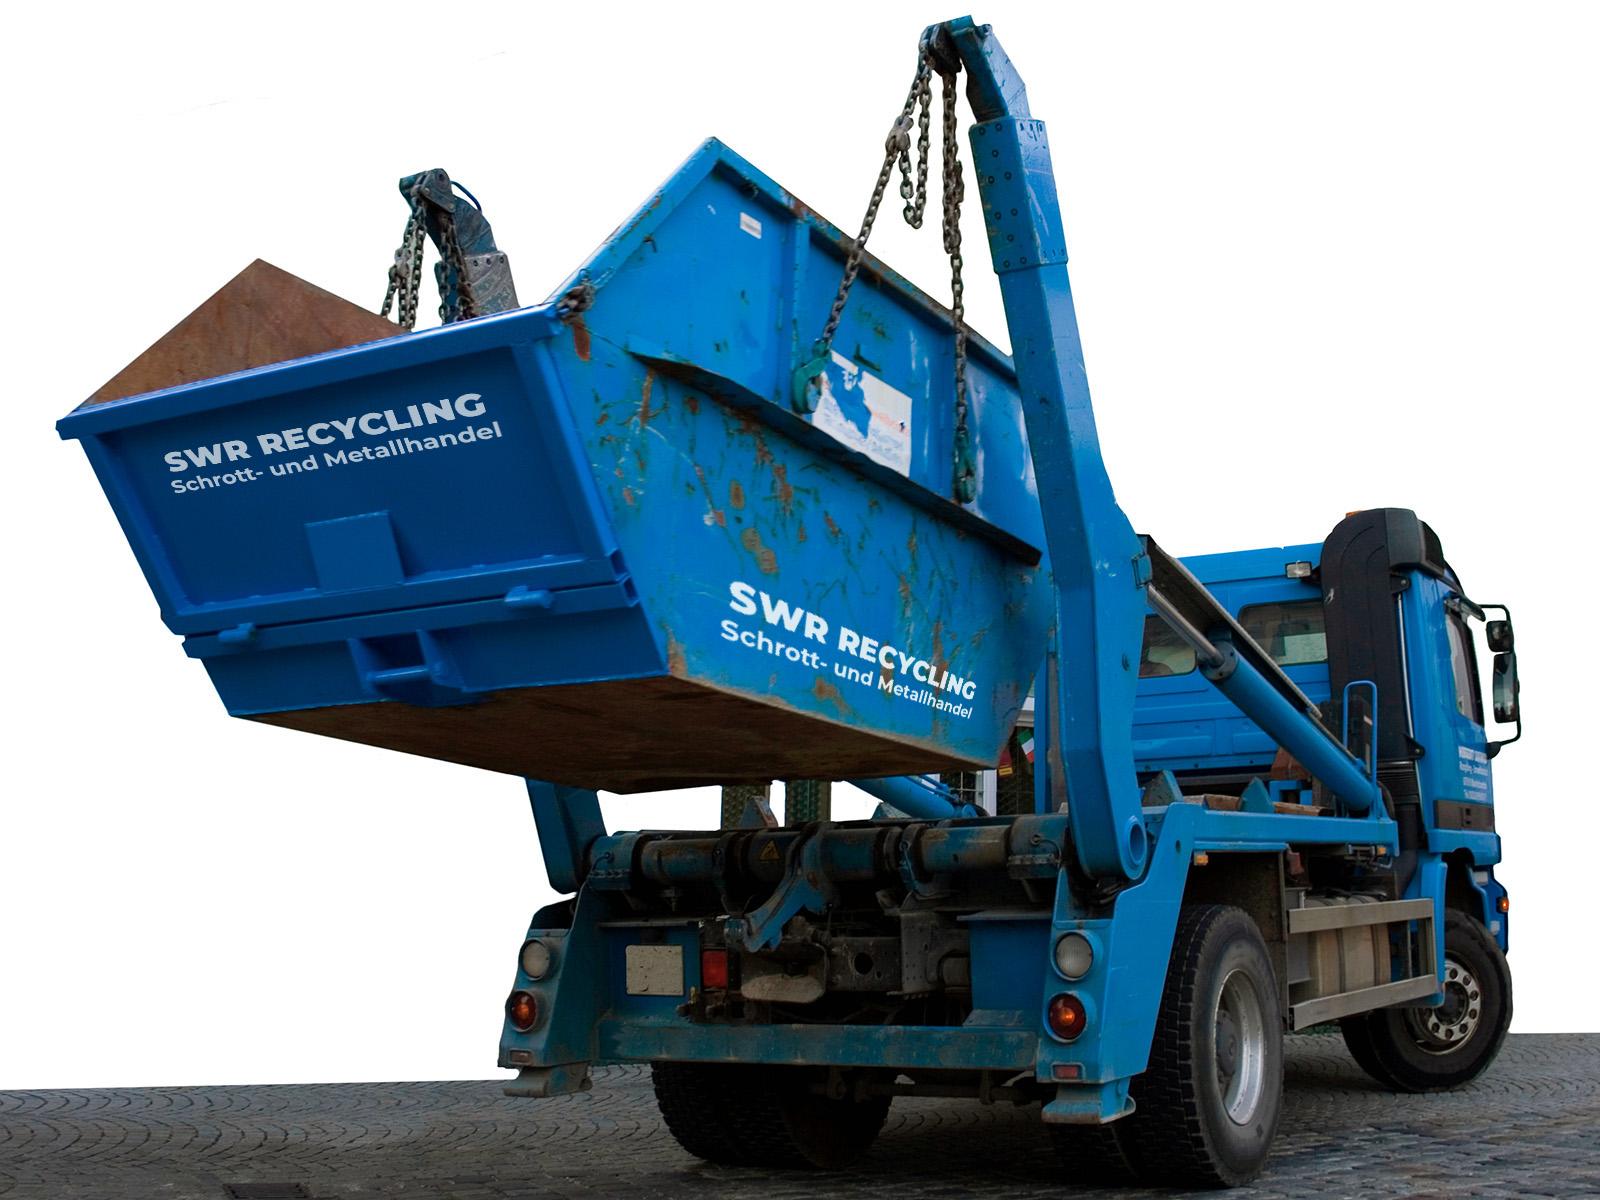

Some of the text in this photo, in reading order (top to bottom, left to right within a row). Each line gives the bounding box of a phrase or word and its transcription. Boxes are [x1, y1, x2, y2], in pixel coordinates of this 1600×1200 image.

[164, 393, 487, 473] SWR RECYCLING
[170, 421, 504, 494] Schrott- und Metallhandel
[720, 619, 974, 720] Schrott- und Metallhandel
[729, 581, 977, 700] SWR RECYCLING
